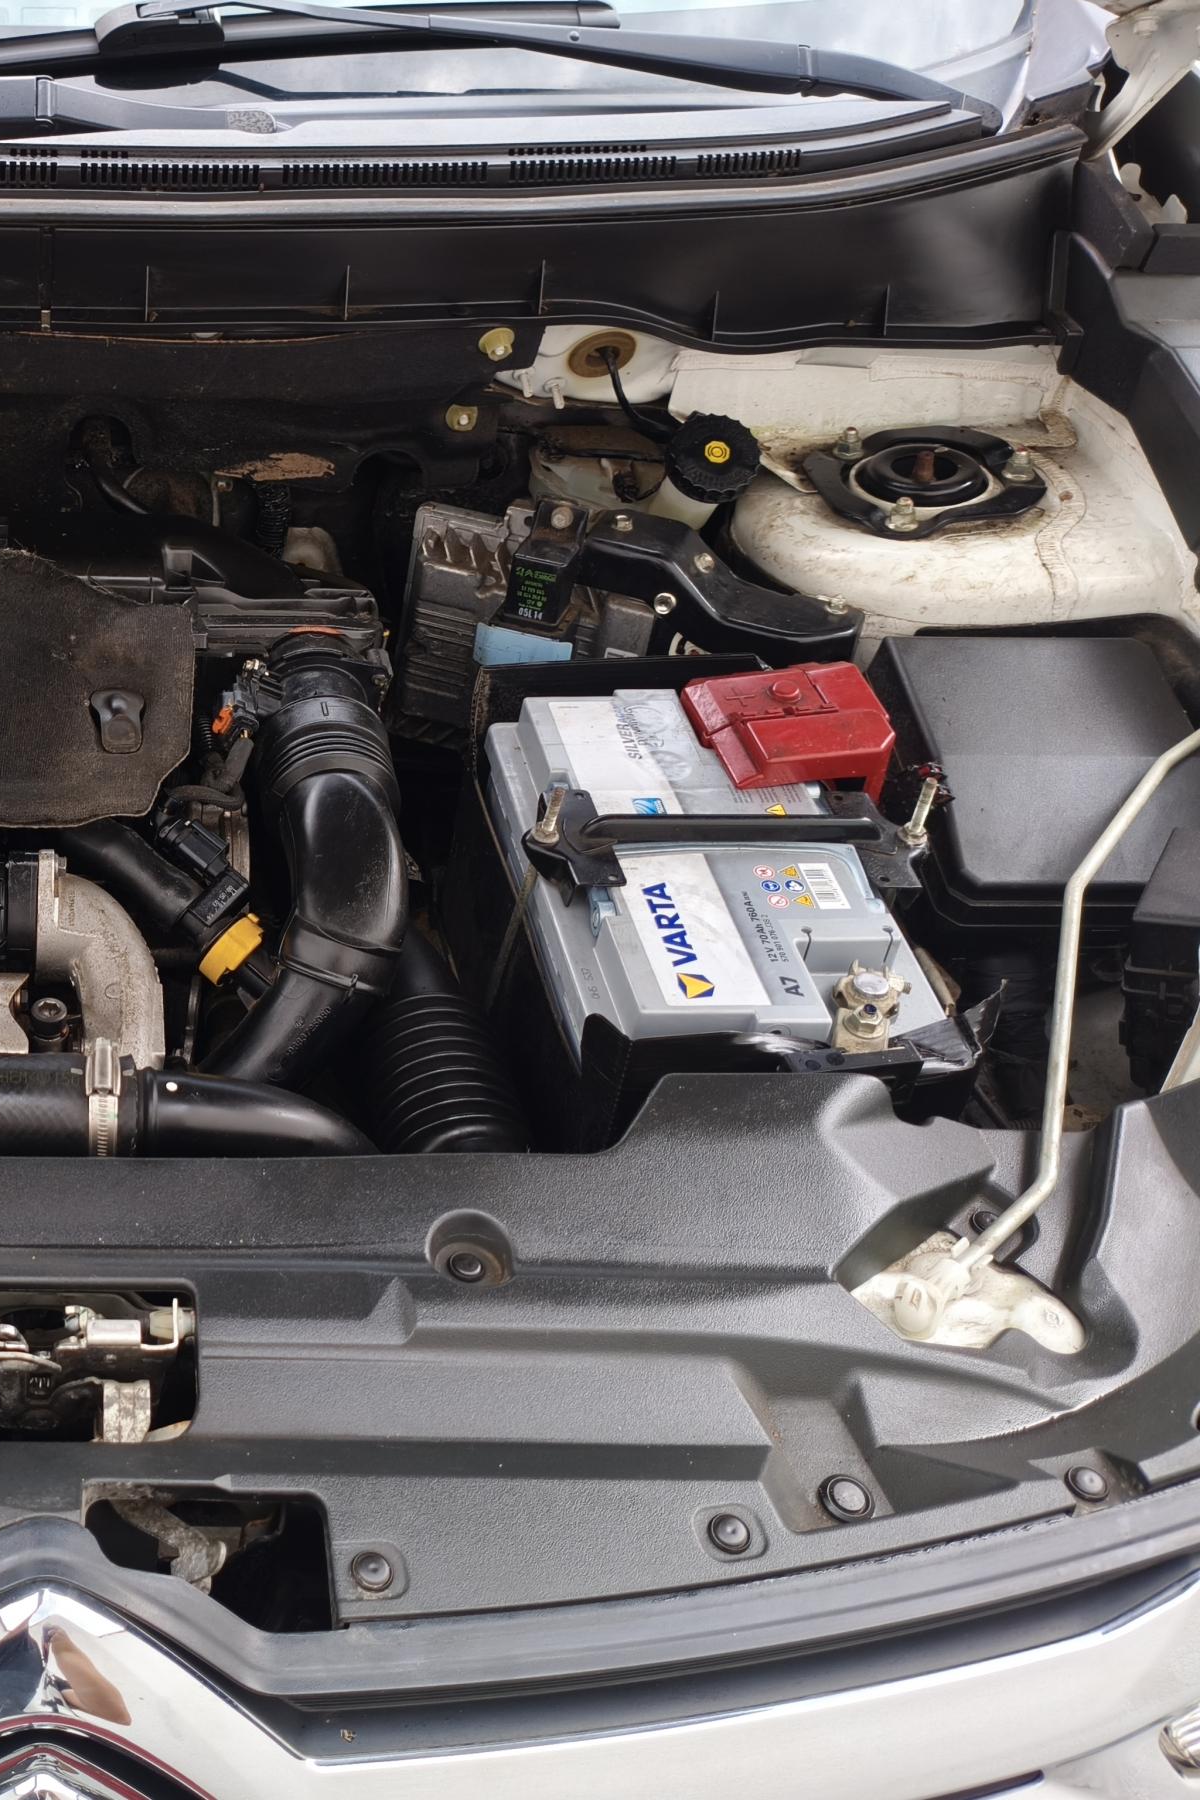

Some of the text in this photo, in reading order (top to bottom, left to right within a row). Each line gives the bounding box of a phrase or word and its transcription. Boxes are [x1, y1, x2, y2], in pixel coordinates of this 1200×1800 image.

[616, 723, 642, 760] SILVER
[640, 881, 698, 968] VARTA
[755, 923, 771, 945] 70Ah
[765, 946, 779, 962] 12V
[778, 976, 805, 997] A7
